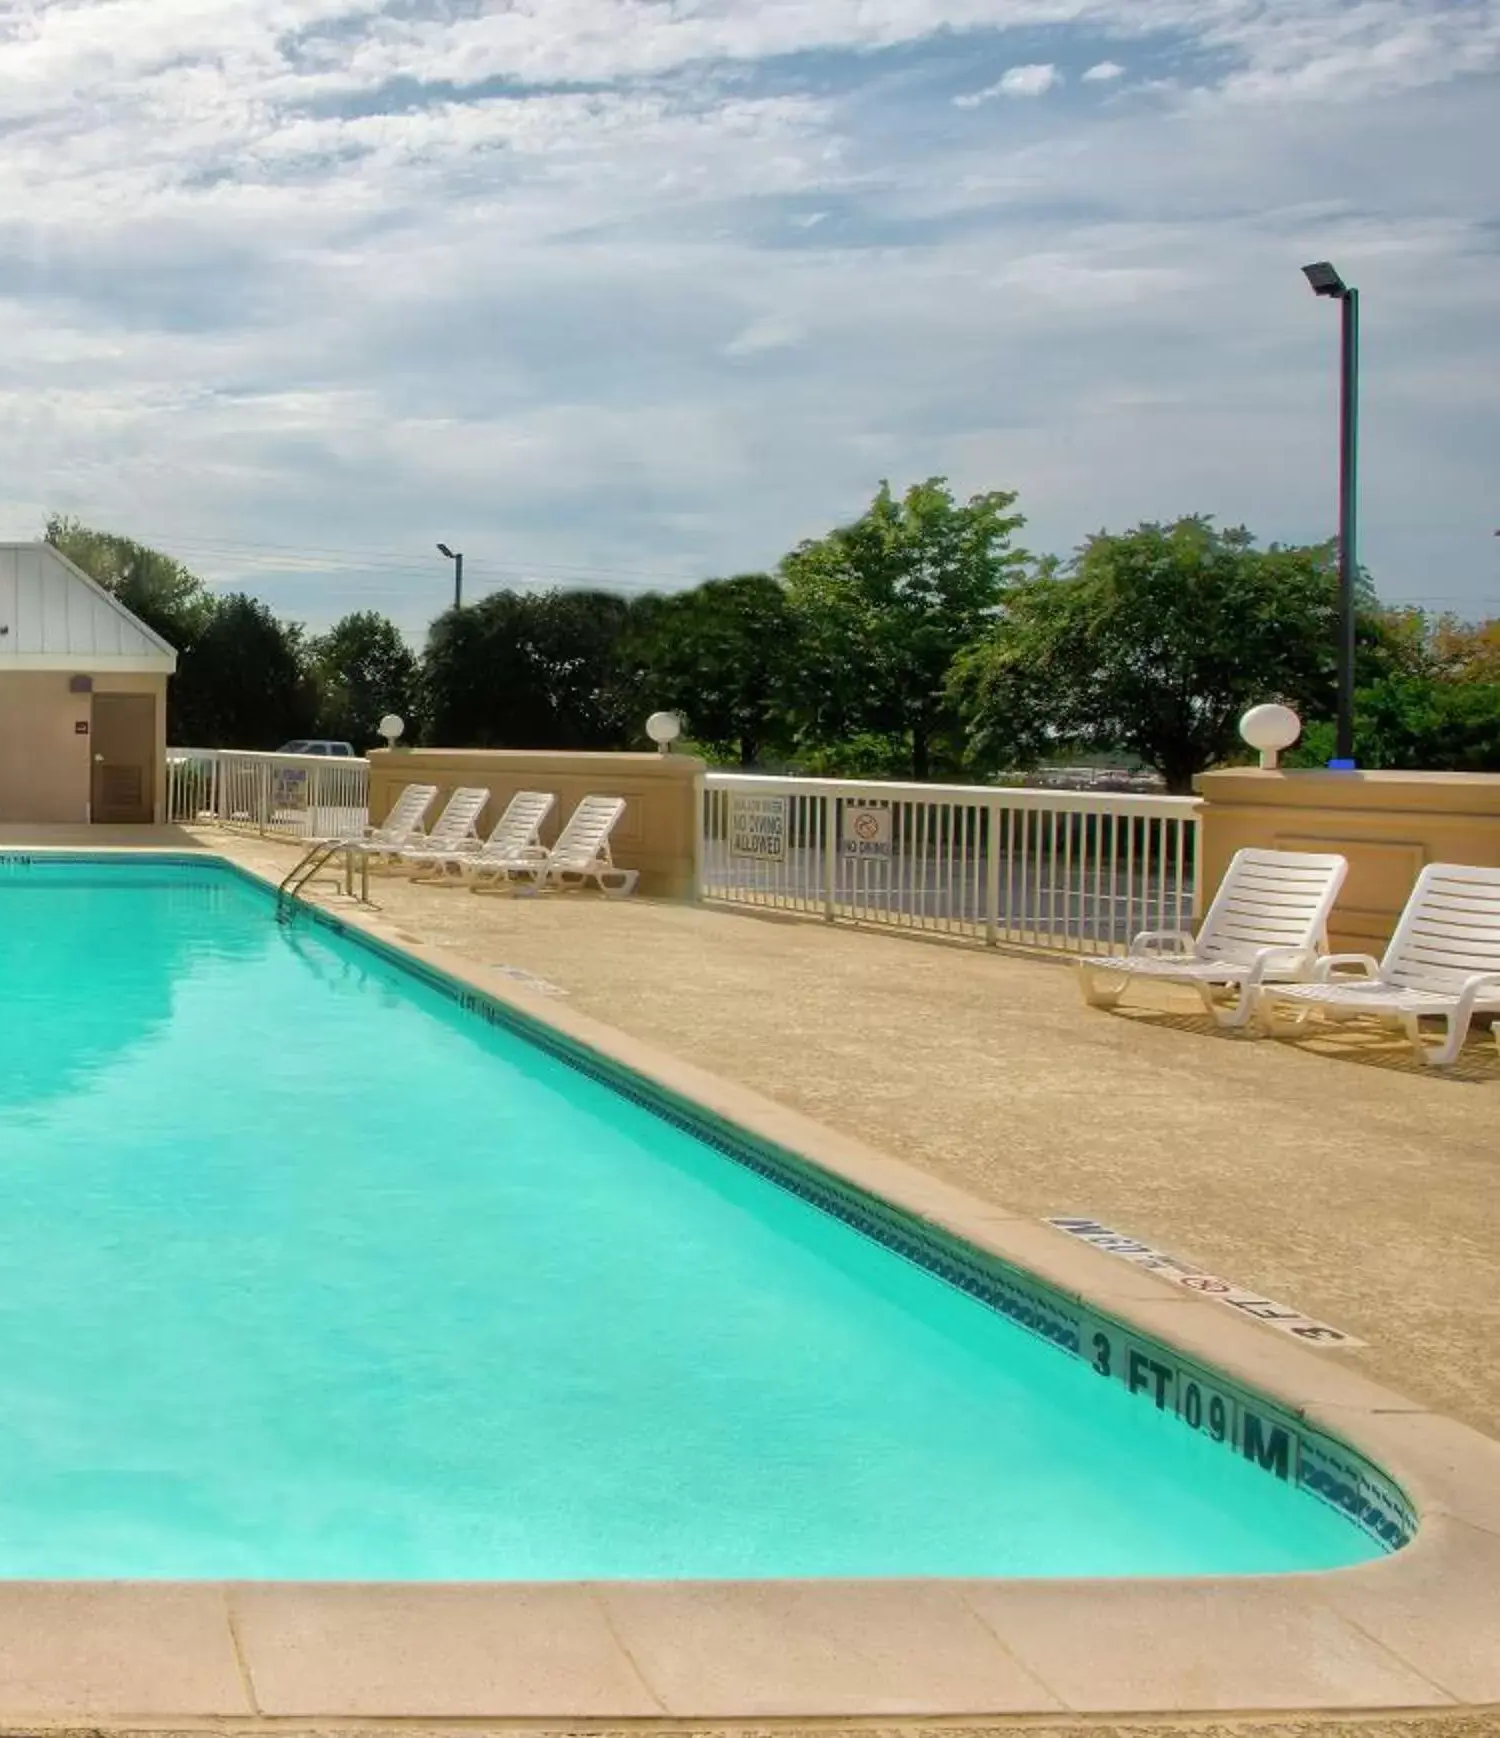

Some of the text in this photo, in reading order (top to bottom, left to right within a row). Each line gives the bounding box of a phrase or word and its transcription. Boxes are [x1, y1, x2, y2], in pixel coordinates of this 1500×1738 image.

[734, 834, 781, 855] ALLOWED
[1092, 1331, 1111, 1377] 3
[1129, 1349, 1173, 1411] FT
[1243, 1410, 1290, 1481] M
